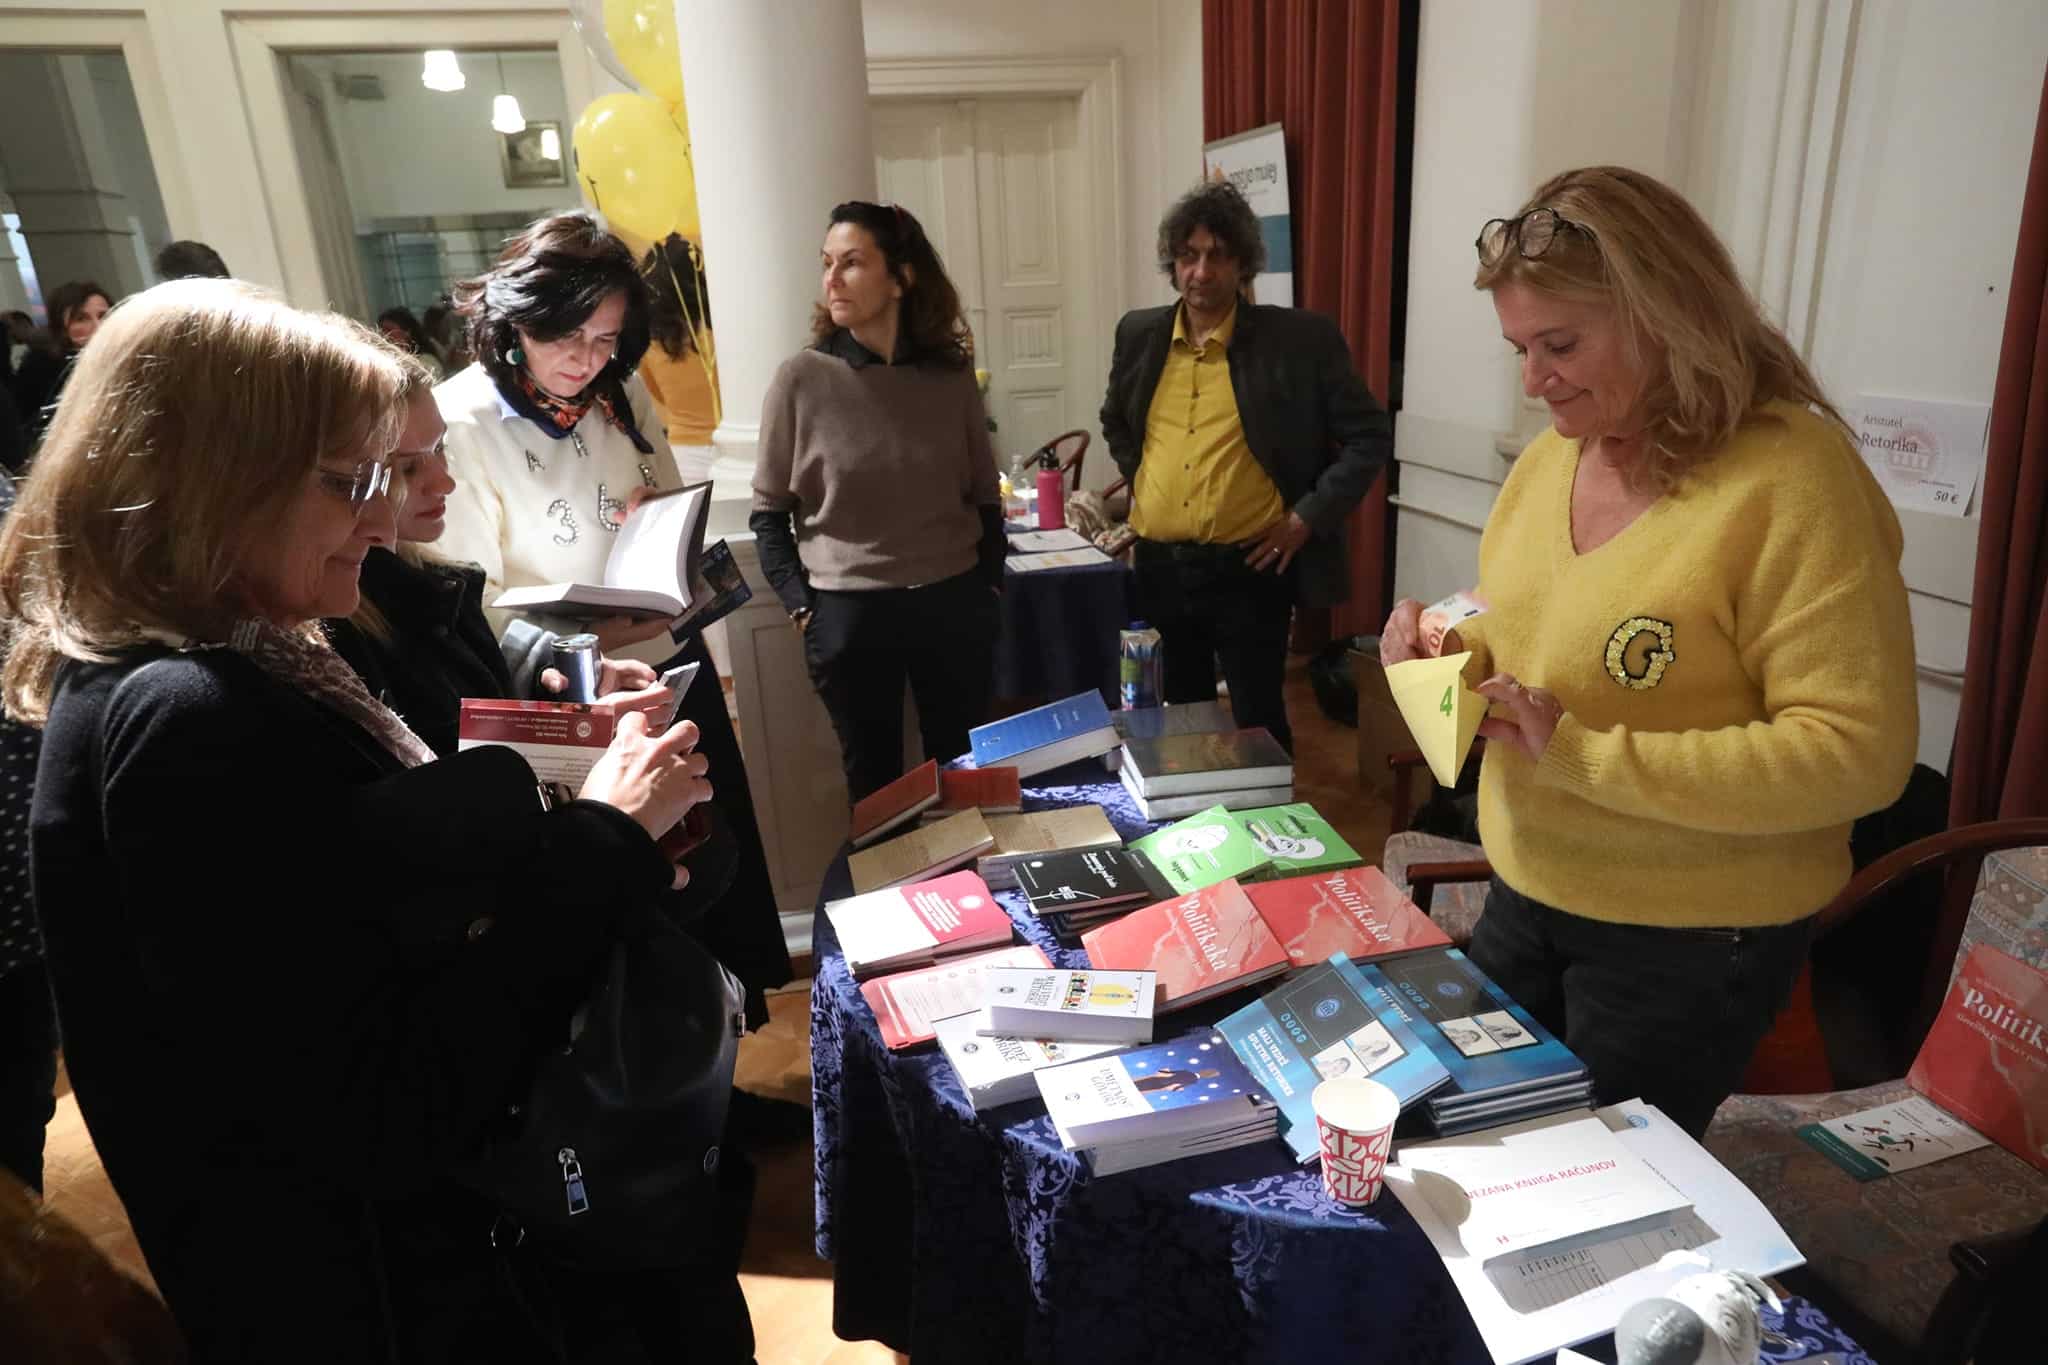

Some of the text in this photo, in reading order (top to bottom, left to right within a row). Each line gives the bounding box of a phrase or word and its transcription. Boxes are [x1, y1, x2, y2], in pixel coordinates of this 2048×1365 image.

[1862, 414, 1903, 429] Aristotel
[1861, 431, 1918, 454] Retorika
[1934, 490, 1960, 505] 50 €
[1603, 615, 1676, 691] G
[1439, 685, 1454, 717] 4
[1962, 988, 2048, 1053] Politik
[1463, 1159, 1618, 1201] VEZANA KNJIGA RAČUNOV
